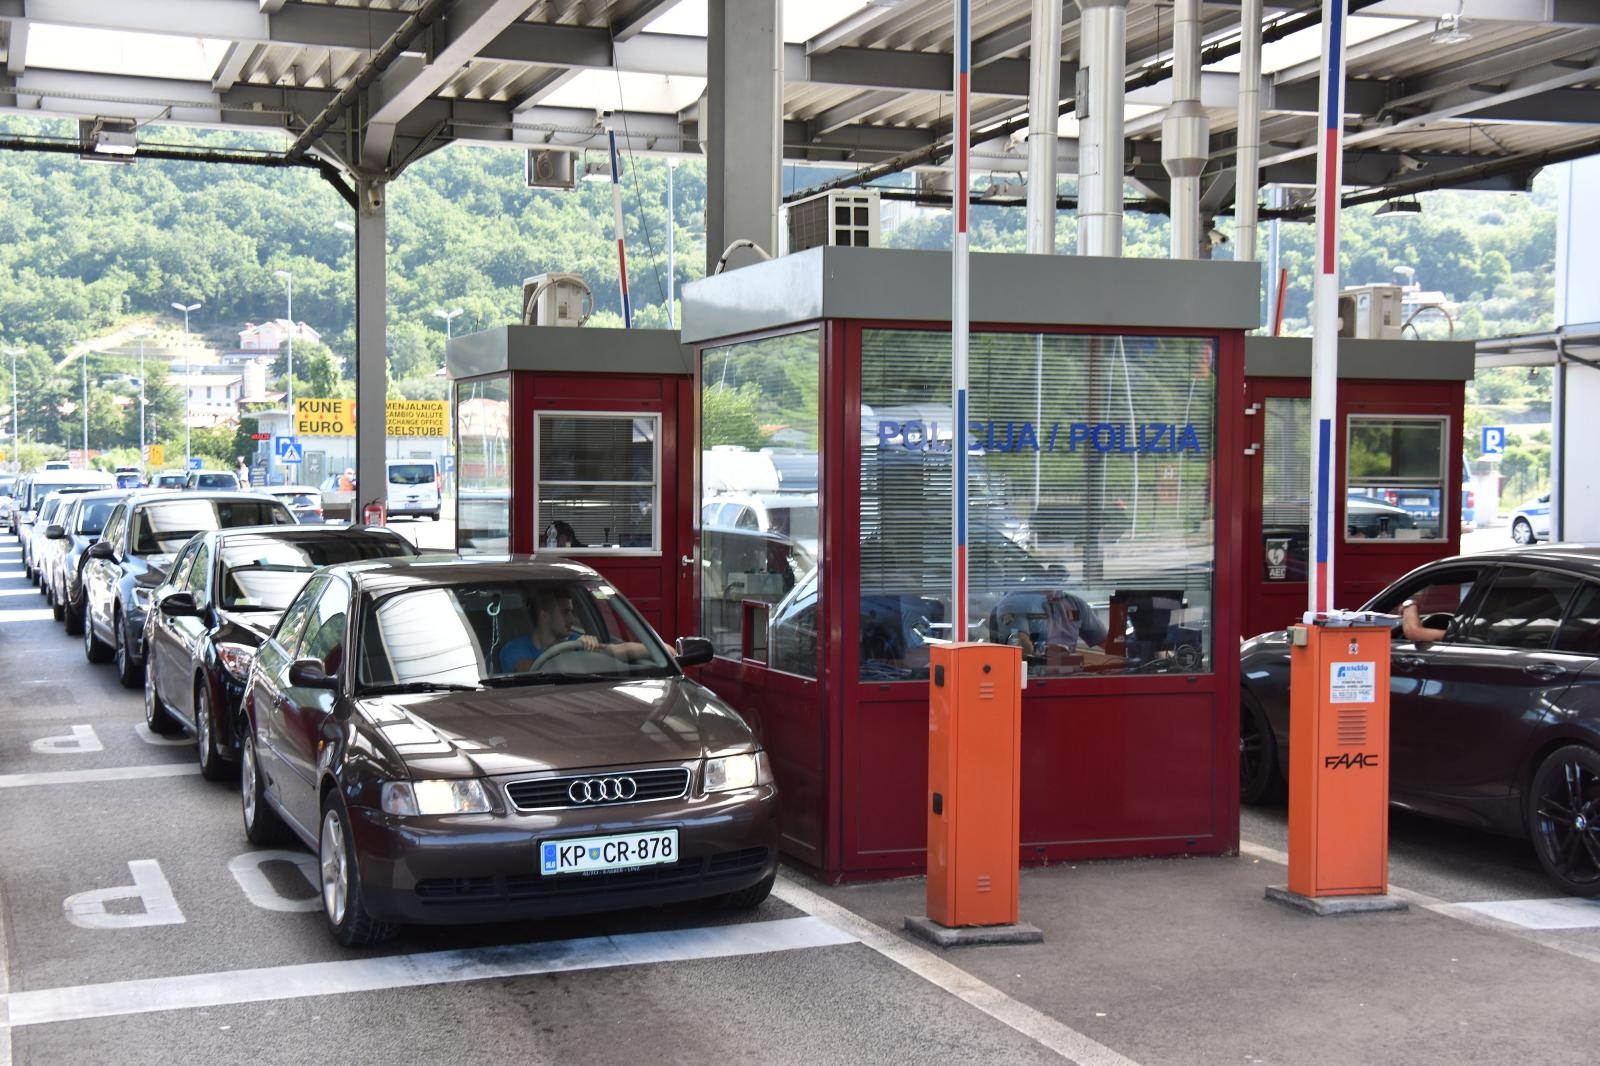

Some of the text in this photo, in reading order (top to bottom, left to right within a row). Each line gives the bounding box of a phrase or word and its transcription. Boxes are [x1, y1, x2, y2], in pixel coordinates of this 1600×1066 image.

[299, 401, 342, 413] KUNE
[299, 421, 343, 433] EURO
[386, 426, 443, 436] SELSTUBE
[879, 420, 1202, 453] POLCIJA / POLIZIA
[444, 457, 454, 470] P
[1325, 753, 1378, 770] FAAC
[560, 836, 672, 867] KP CR-878
